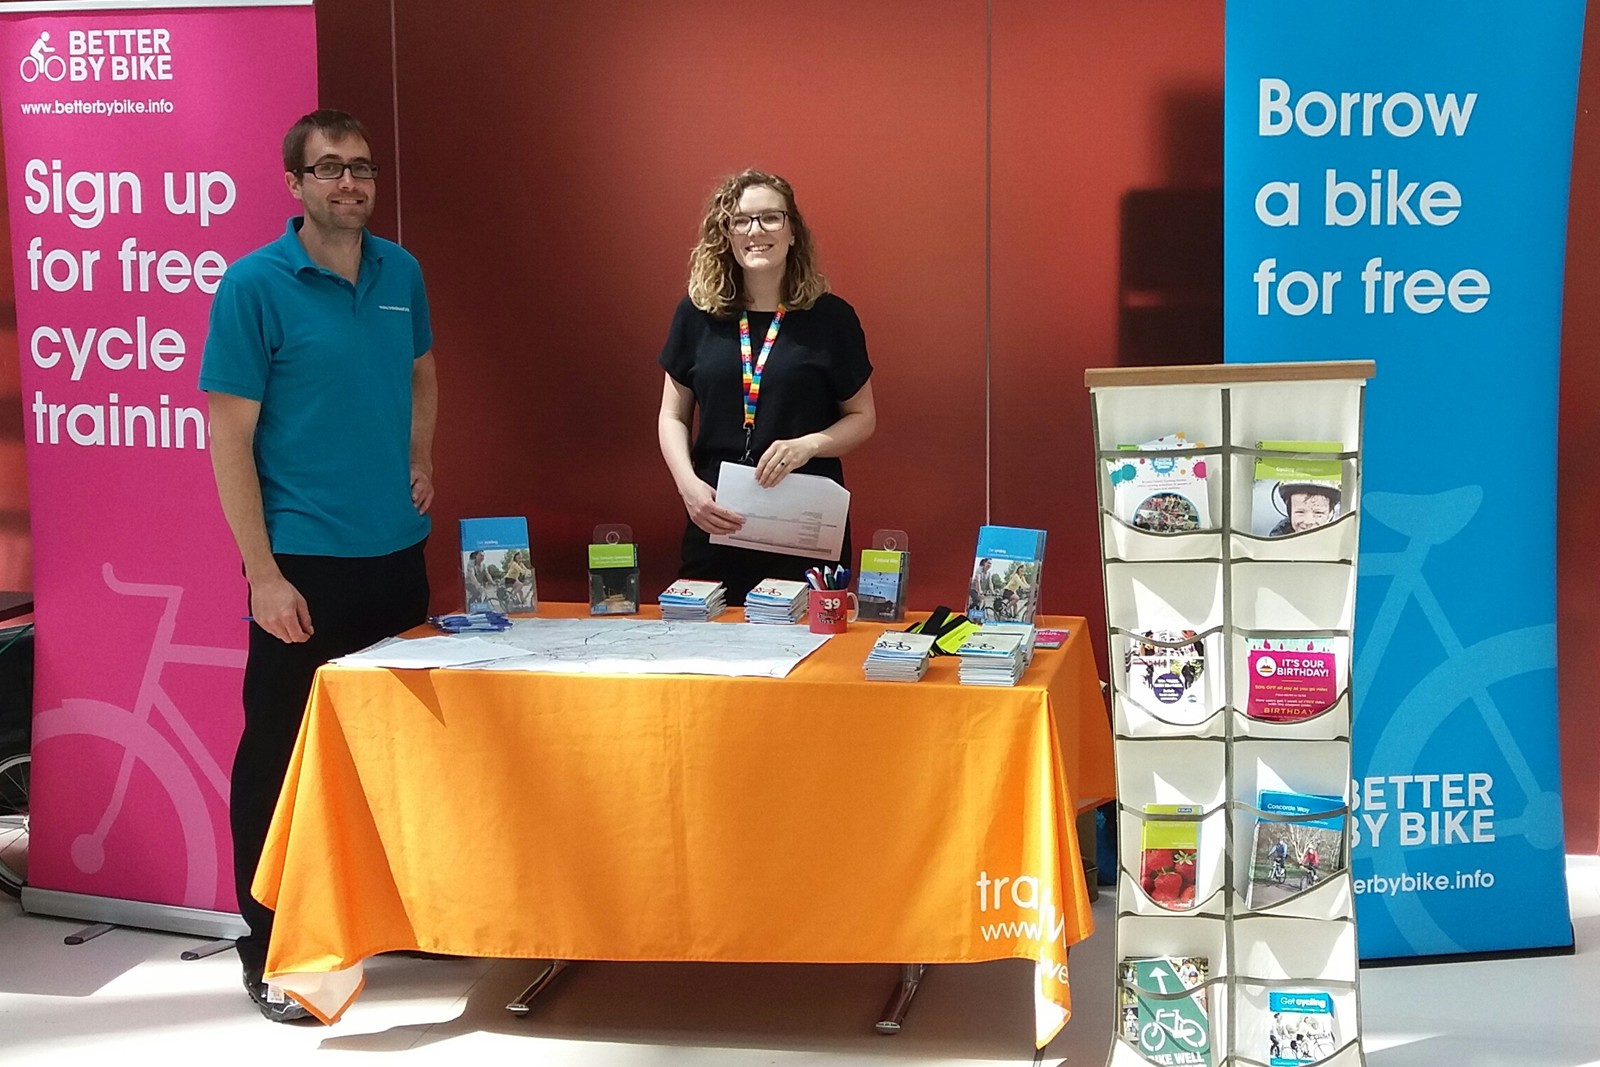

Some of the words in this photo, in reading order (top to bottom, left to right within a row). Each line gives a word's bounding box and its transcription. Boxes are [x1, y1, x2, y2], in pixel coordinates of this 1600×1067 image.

[69, 28, 171, 55] BETTER
[70, 55, 105, 81] BY
[112, 54, 173, 81] BIKE
[21, 98, 174, 116] www.betterbybike.info
[1259, 78, 1478, 137] Borrow
[24, 158, 142, 229] Sign
[164, 169, 236, 227] up
[1255, 181, 1300, 227] a
[1325, 168, 1462, 227] bike
[27, 237, 100, 292] for
[118, 237, 228, 294] free
[1253, 258, 1342, 316] for
[1361, 257, 1491, 314] free
[30, 316, 186, 381] cycle
[32, 390, 212, 450] trainin
[824, 597, 841, 610] 39
[1276, 667, 1329, 678] BIRTHDAY!
[1281, 658, 1300, 668] IT'S
[1302, 659, 1325, 669] OUR
[1263, 707, 1315, 715] BIRTHDAY
[1267, 803, 1296, 812] Concorde
[1296, 805, 1310, 814] Way
[1400, 809, 1497, 847] BIKE
[1353, 868, 1496, 897] erbybike.info
[1280, 996, 1295, 1006] Get
[1295, 997, 1327, 1010] cycling
[1174, 1051, 1205, 1065] WELL
